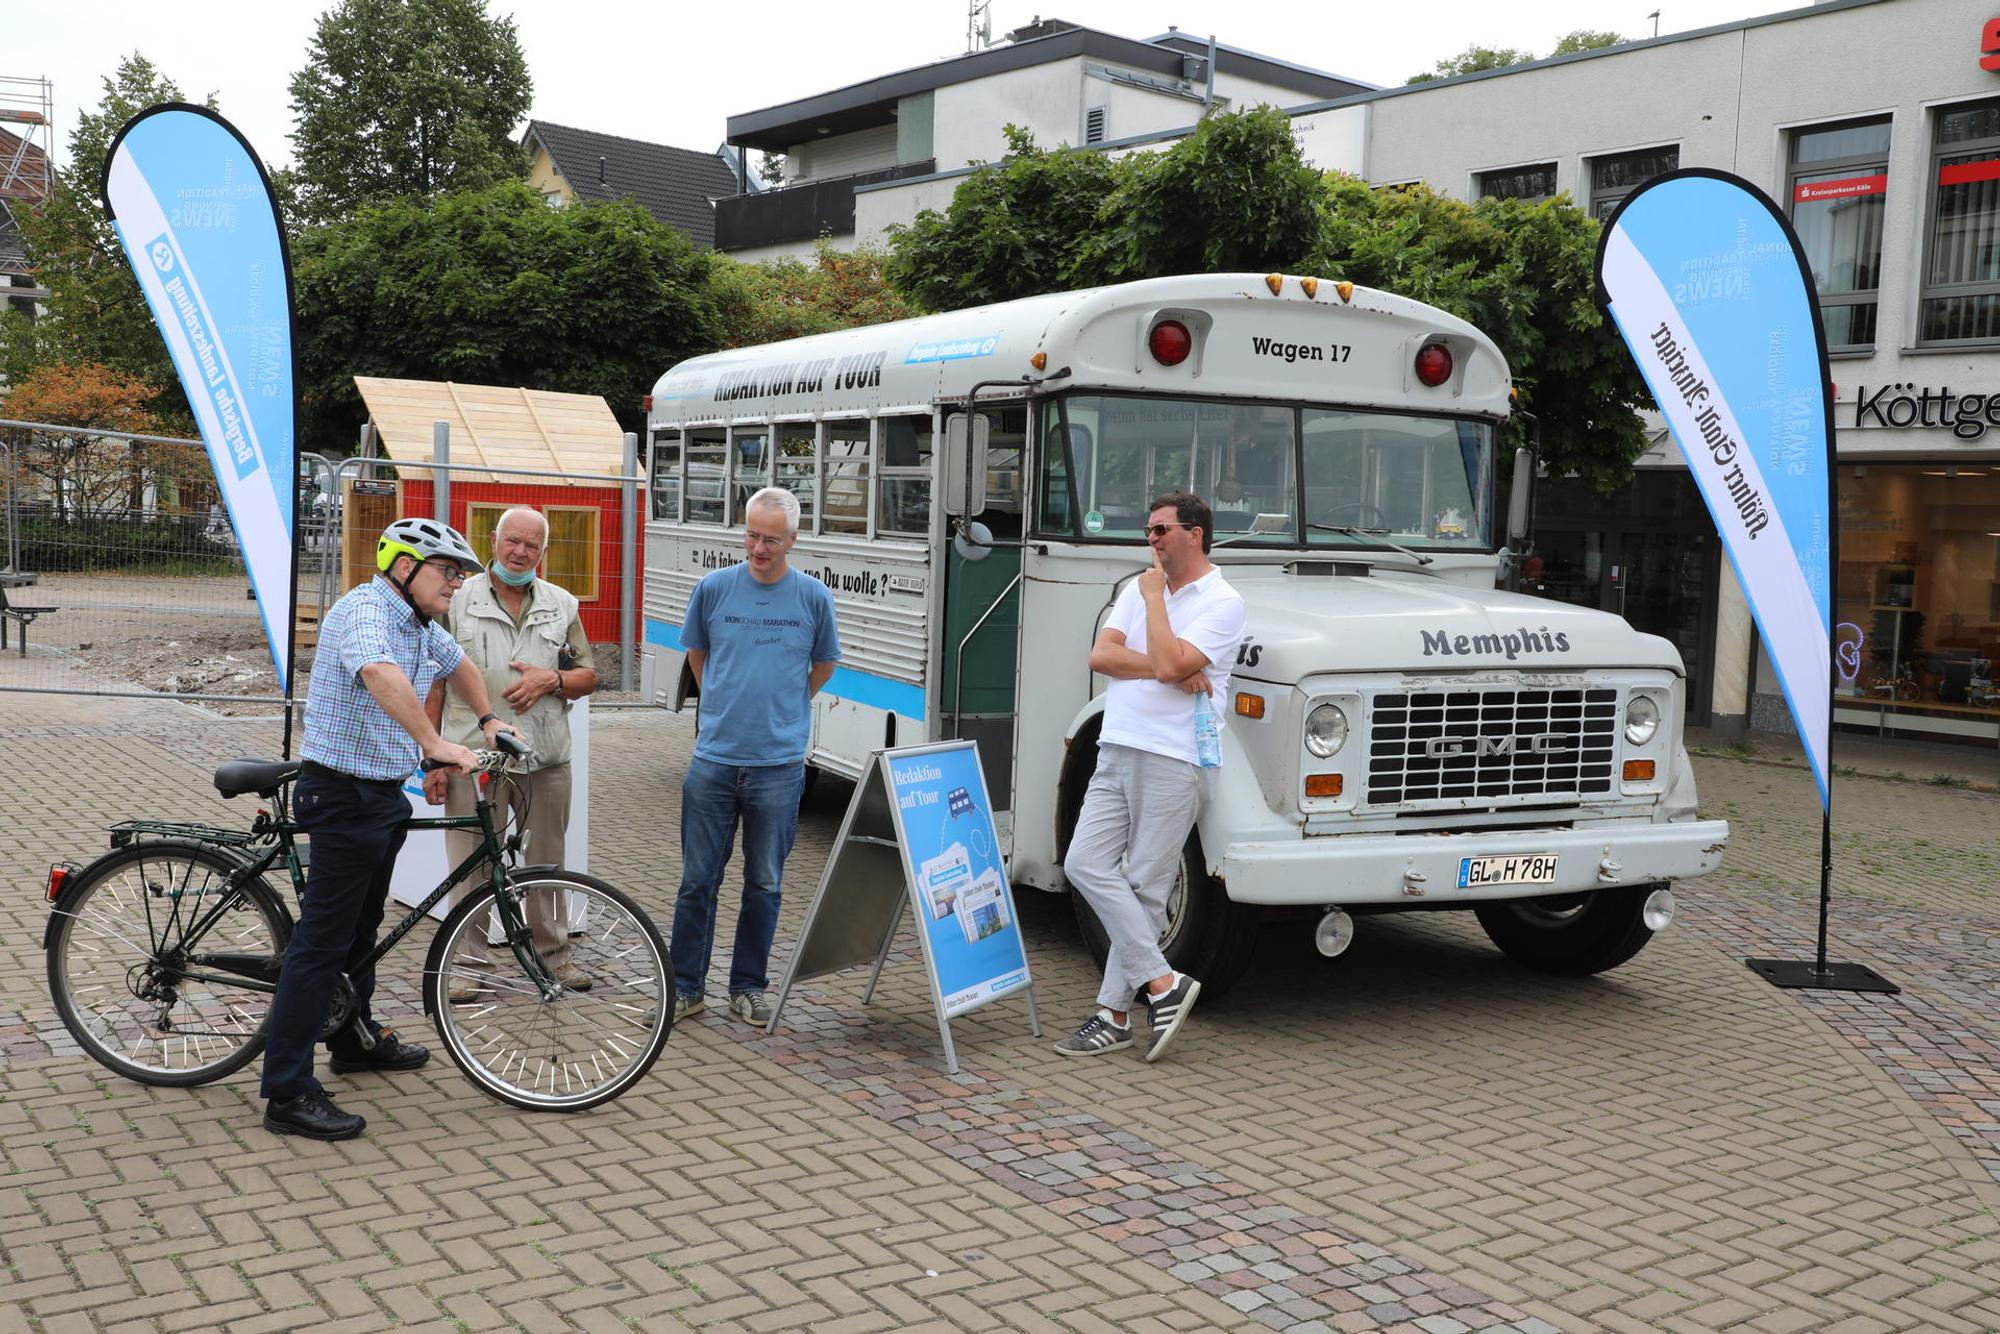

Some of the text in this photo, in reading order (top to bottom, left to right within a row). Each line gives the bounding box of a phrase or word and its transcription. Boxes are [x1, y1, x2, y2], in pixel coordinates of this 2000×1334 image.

[1252, 336, 1352, 363] Wagen 17
[714, 350, 888, 402] REDAKTION AUF TOUR
[702, 549, 717, 569] Ich
[823, 566, 840, 590] Du
[843, 570, 878, 595] wolle
[880, 573, 889, 597] ?
[762, 618, 800, 628] MARATHON
[1420, 626, 1571, 660] Memphis
[1426, 732, 1568, 760] GMC
[893, 764, 943, 785] Redaktion
[900, 790, 939, 809] auf Tour
[1469, 860, 1491, 883] GL
